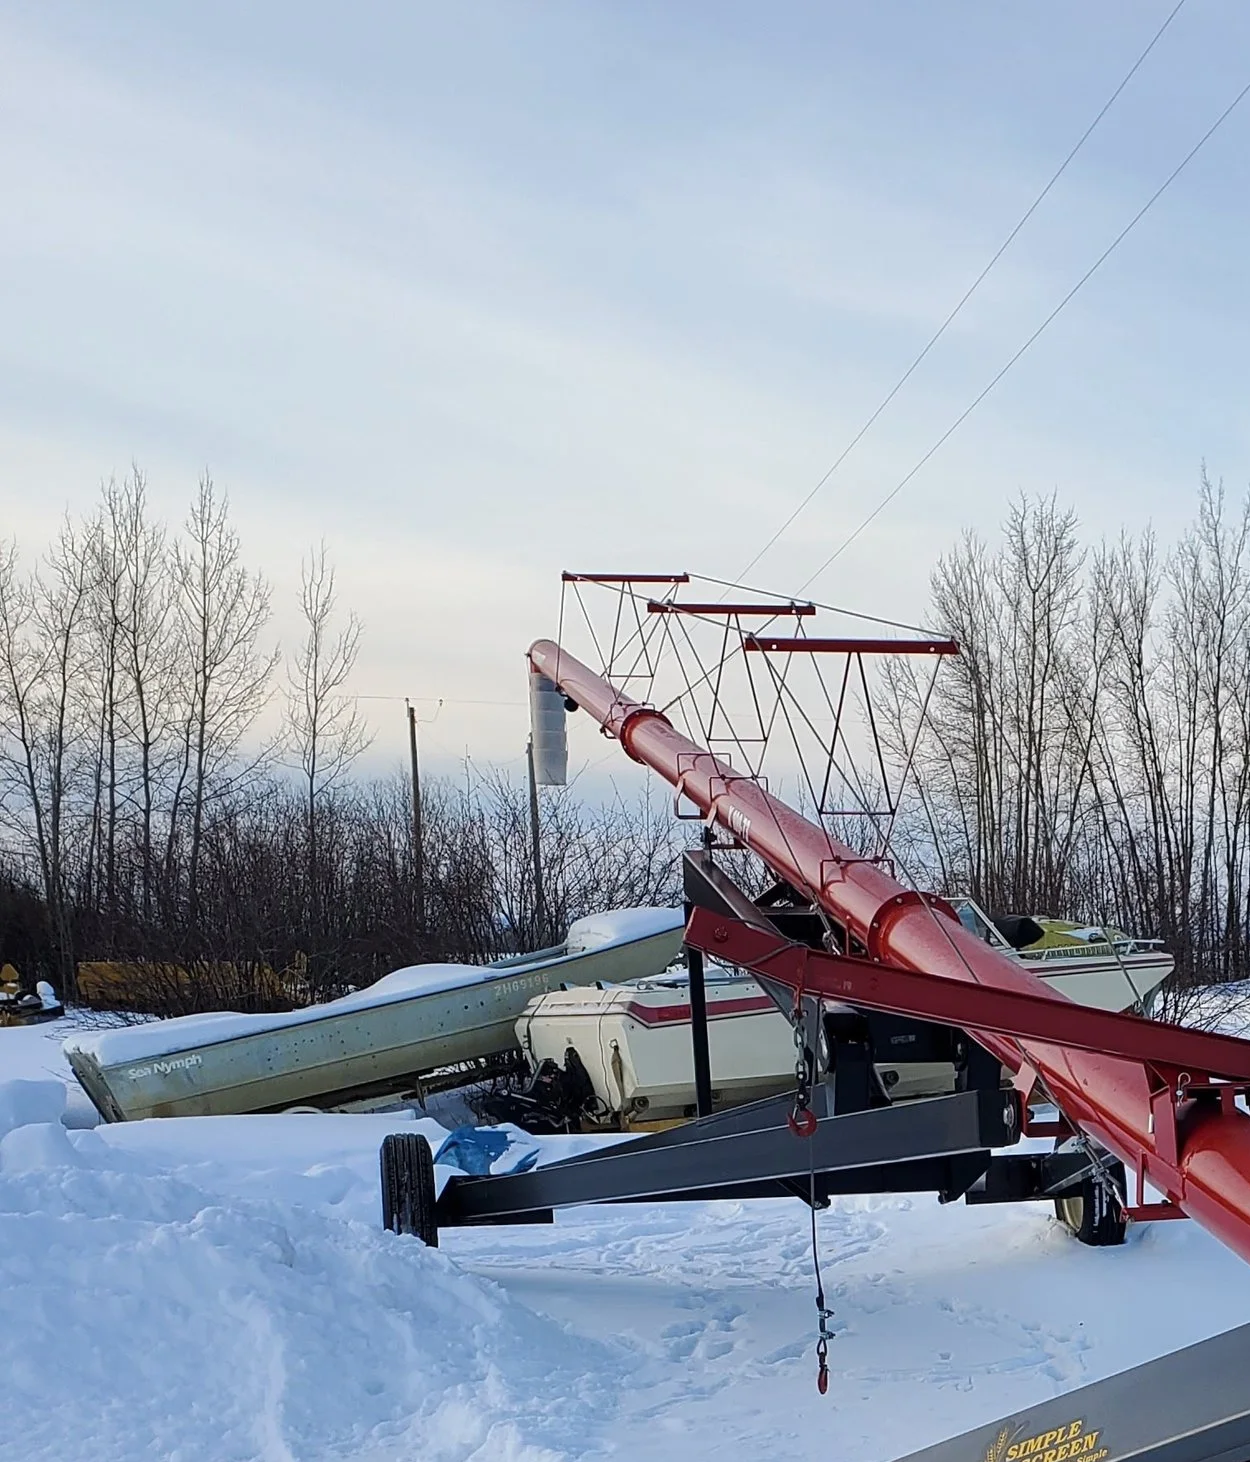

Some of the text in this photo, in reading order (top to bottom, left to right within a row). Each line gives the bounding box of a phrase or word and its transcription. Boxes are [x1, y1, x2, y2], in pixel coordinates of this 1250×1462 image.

[128, 1054, 203, 1080] Sea Nymph
[1005, 1420, 1083, 1462] SIMPLE
